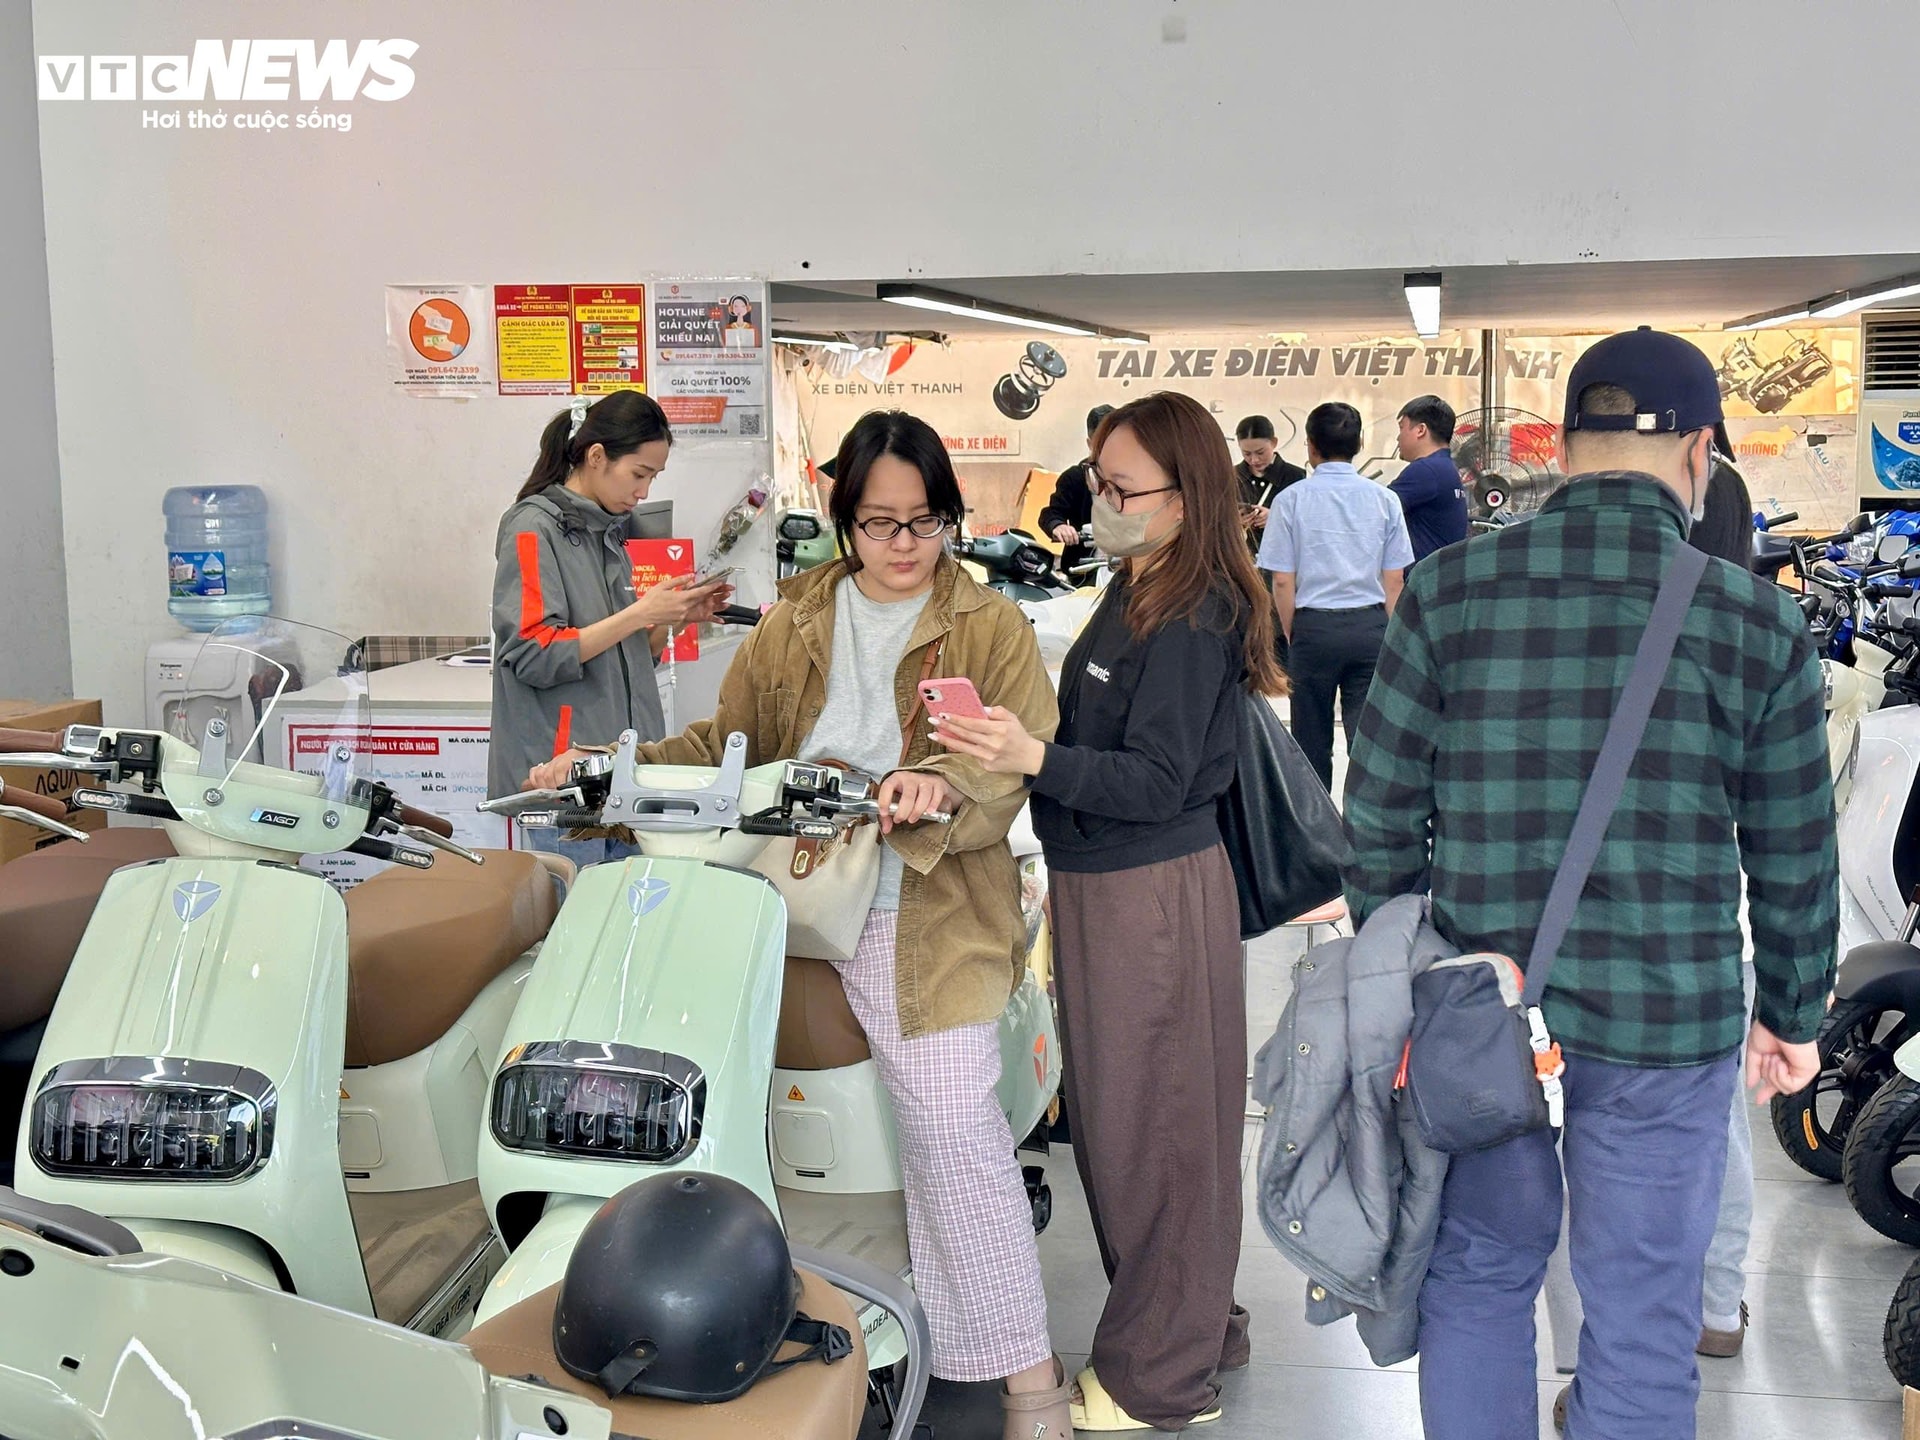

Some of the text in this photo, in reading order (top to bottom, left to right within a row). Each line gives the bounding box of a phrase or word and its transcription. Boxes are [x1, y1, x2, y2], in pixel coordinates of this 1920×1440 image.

[658, 308, 705, 317] HOTLINE
[659, 318, 721, 330] GIẢI QUYẾT
[659, 331, 715, 344] KHIẾU NẠI
[428, 366, 480, 374] 091.647.3399
[1097, 350, 1158, 387] TẠI
[1163, 349, 1218, 377] XE
[1224, 340, 1321, 387] ĐIỆN
[1331, 341, 1416, 386] VIỆT
[690, 378, 718, 386] QUYẾT
[720, 376, 751, 386] 100%
[812, 381, 963, 397] XE ĐIỆN VIỆT THANH
[967, 437, 980, 450] XE
[983, 434, 1007, 452] ĐIỆN
[1814, 447, 1830, 465] ALU
[1768, 497, 1784, 515] ALU
[398, 740, 414, 751] CỬA
[416, 741, 436, 751] HÀNG
[863, 1309, 889, 1339] YADEA
